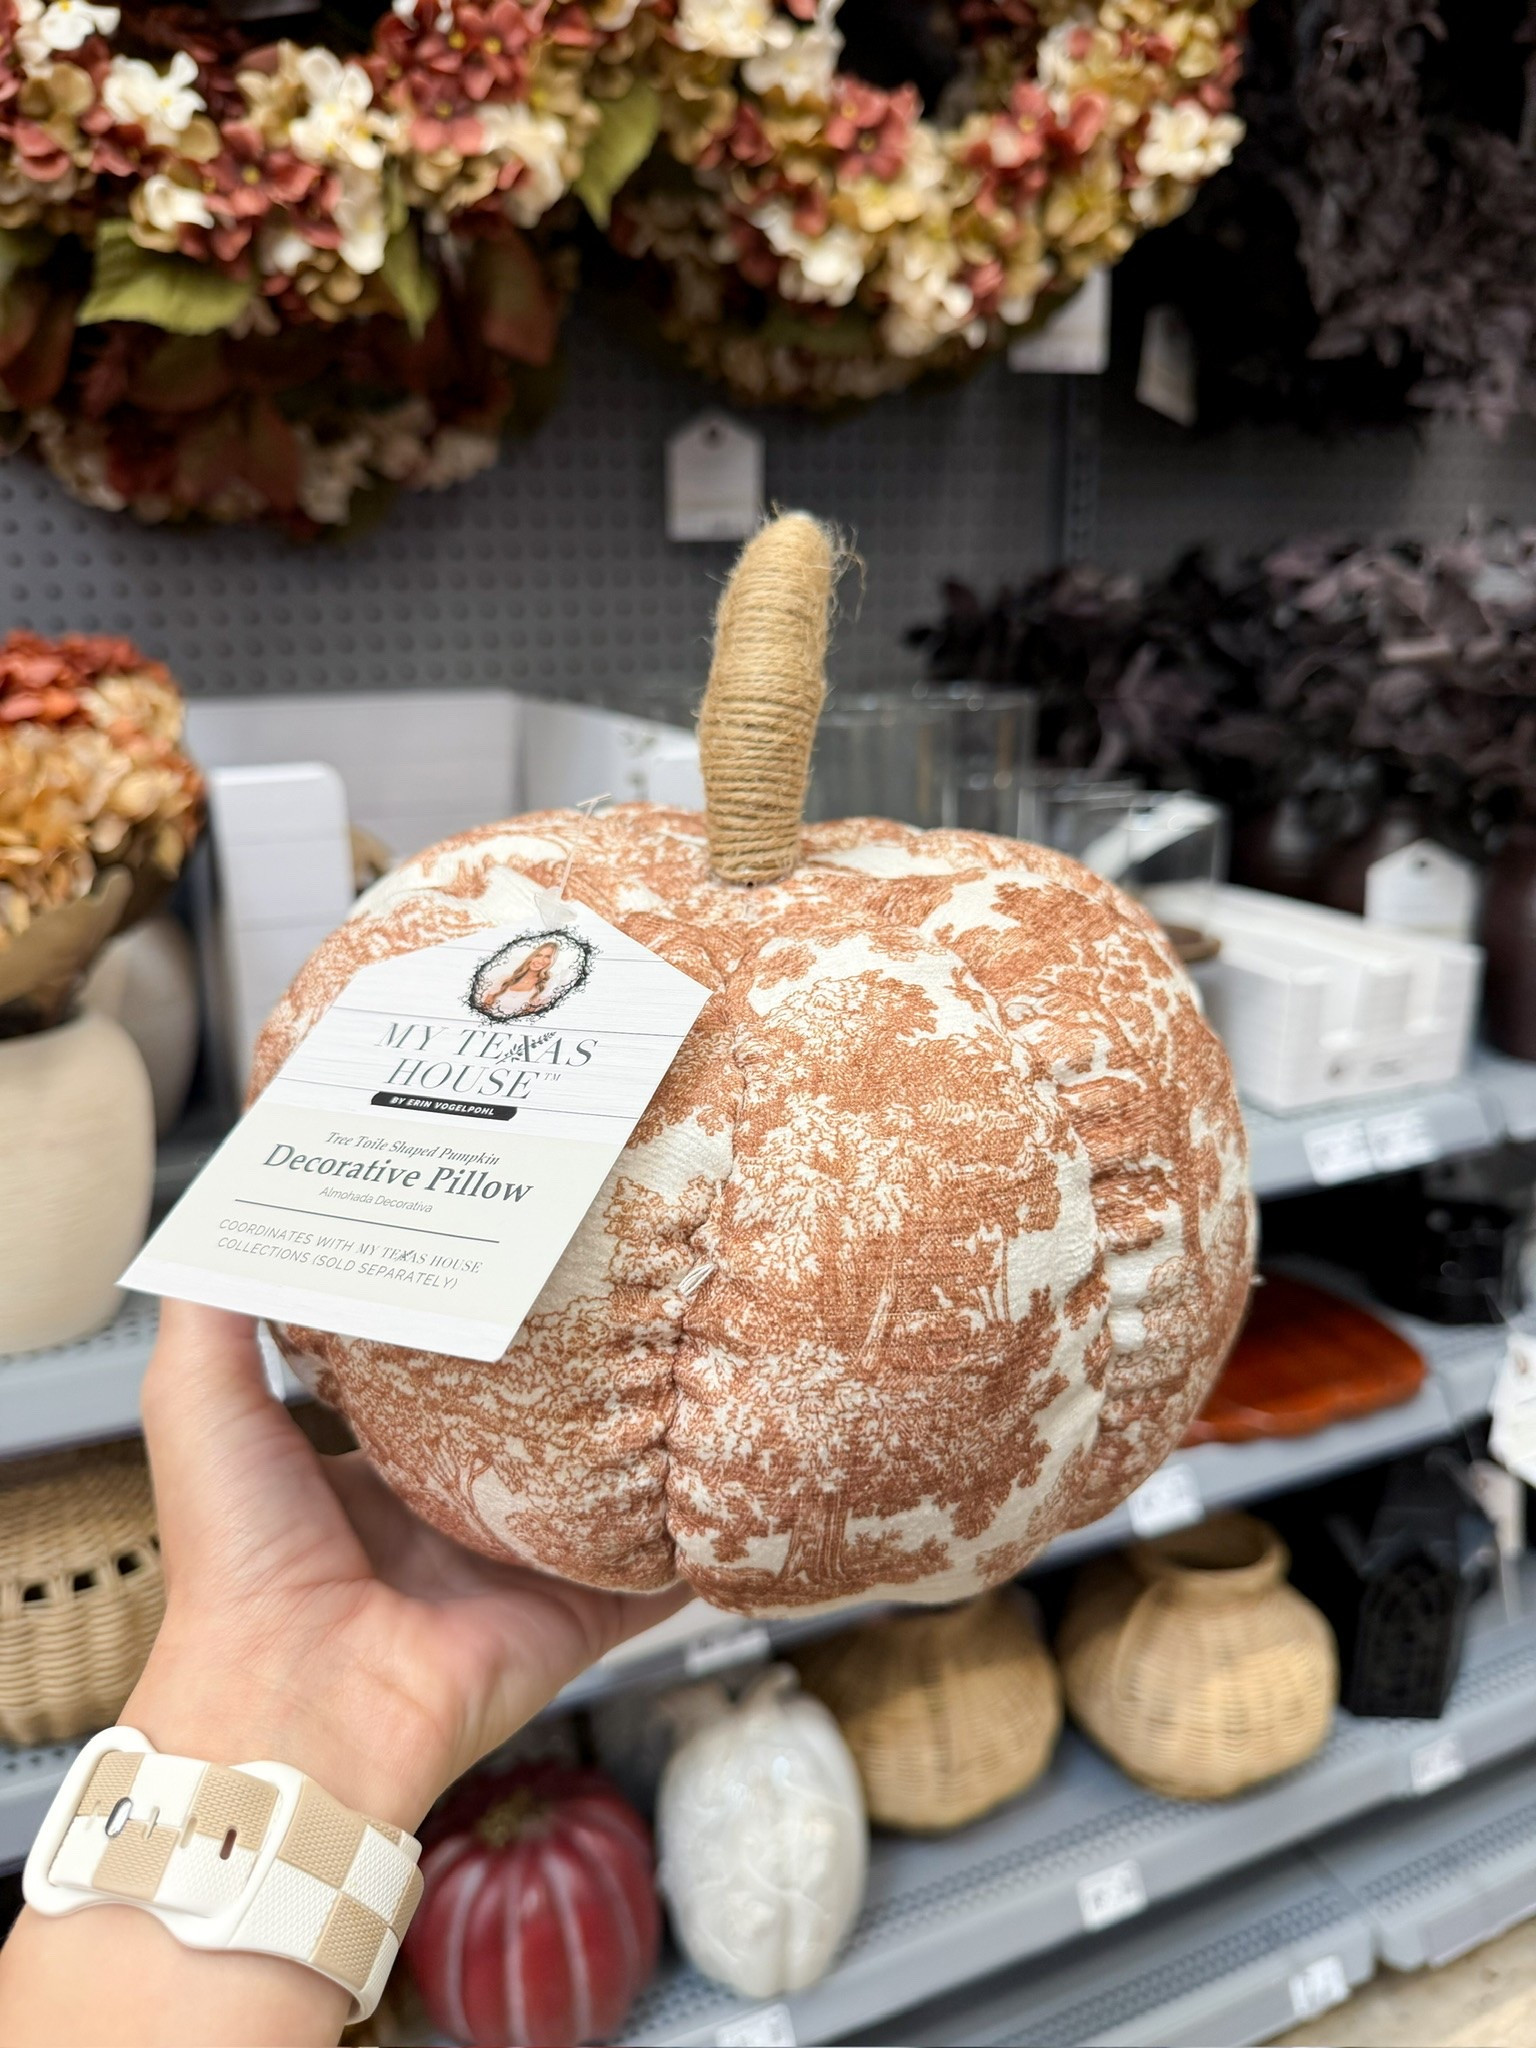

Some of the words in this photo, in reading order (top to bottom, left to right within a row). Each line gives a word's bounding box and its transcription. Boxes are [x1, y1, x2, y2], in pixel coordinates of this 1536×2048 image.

[375, 1022, 448, 1051] MY
[453, 1029, 598, 1066] TEXAS
[390, 1096, 406, 1107] BY
[407, 1097, 433, 1110] ERIN
[434, 1101, 496, 1116] VOGELPOHL
[325, 1131, 352, 1147] Tree
[354, 1135, 389, 1152] Toile
[388, 1140, 440, 1161] Shaped
[439, 1147, 501, 1167] Pumpkin
[262, 1143, 422, 1188] Decorative
[424, 1166, 535, 1204] Pillow
[318, 1186, 374, 1205] Almohada
[374, 1194, 434, 1214] Decorativa
[217, 1237, 316, 1264] COLLECTIONS
[312, 1253, 356, 1273] (SOLD
[357, 1261, 459, 1291] SEPARATELY)
[219, 1218, 315, 1246] COORDINATES
[316, 1236, 355, 1253] WITH
[355, 1242, 380, 1257] MY
[380, 1245, 428, 1266] TEXAS
[428, 1255, 484, 1275] HOUSE
